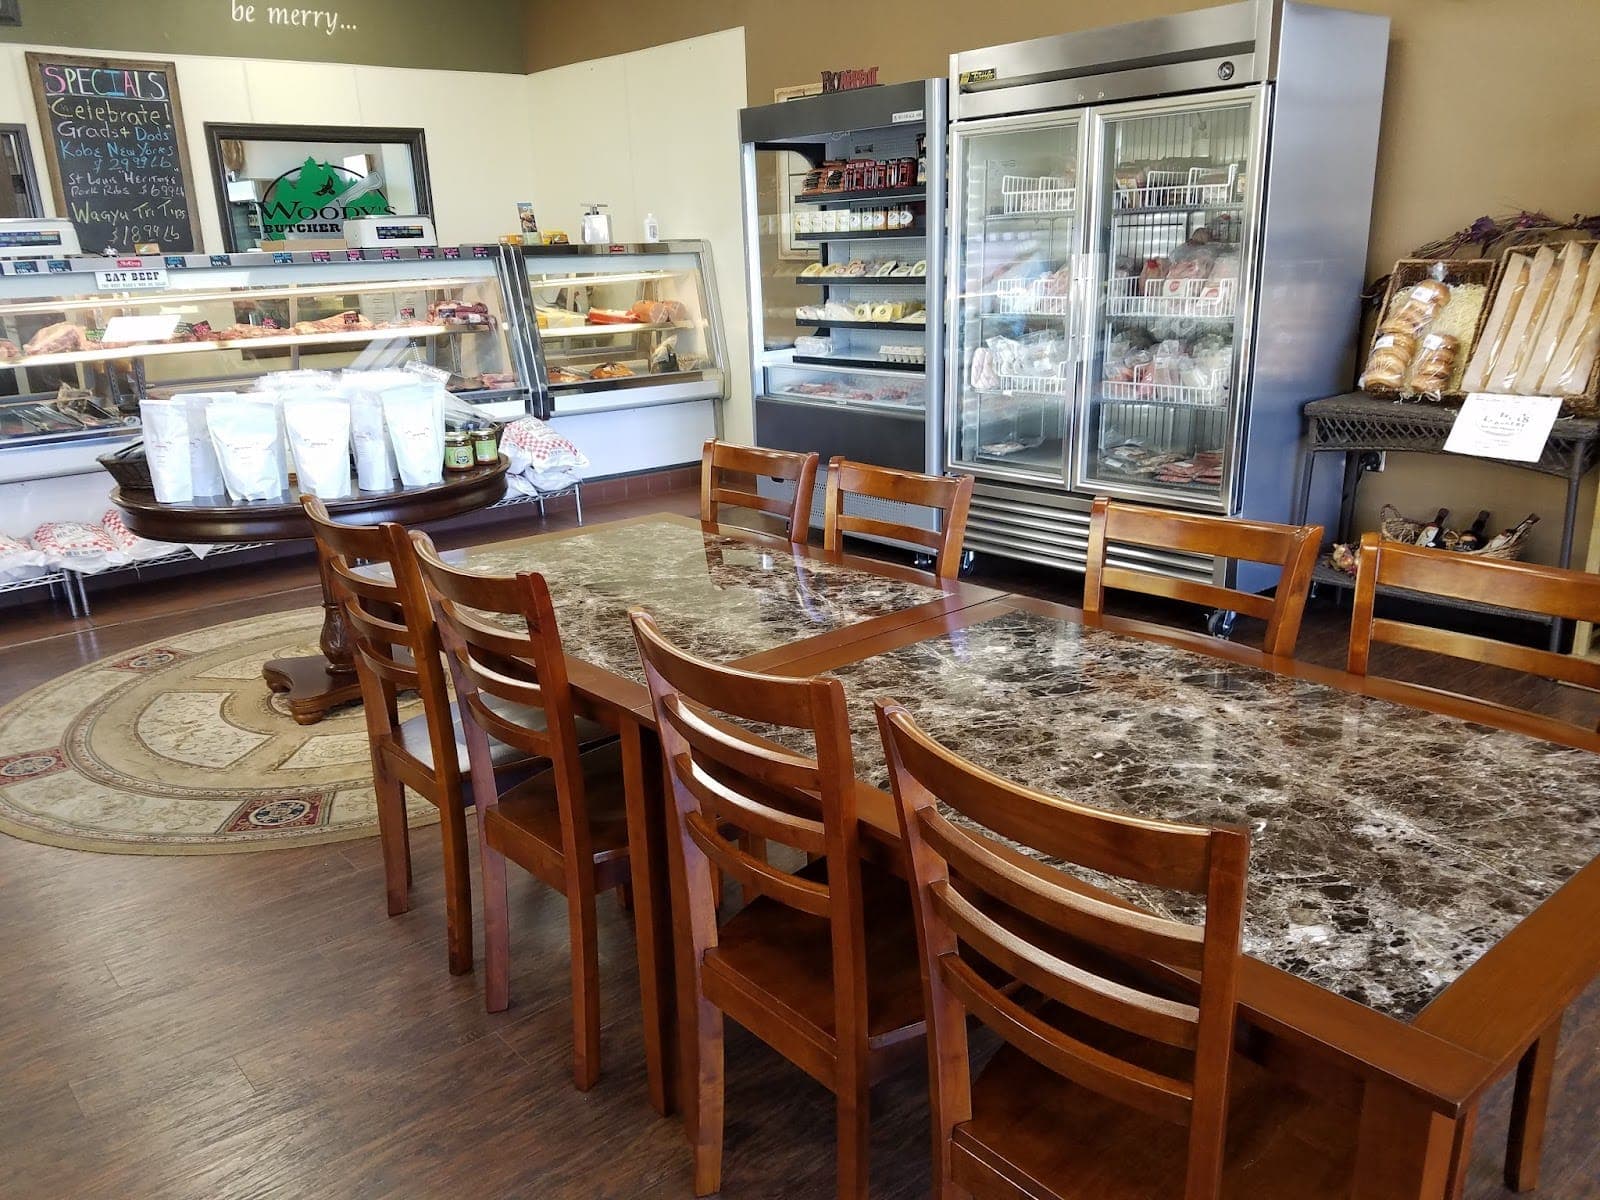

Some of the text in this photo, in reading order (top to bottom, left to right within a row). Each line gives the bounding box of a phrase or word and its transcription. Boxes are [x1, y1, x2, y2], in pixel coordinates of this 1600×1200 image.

[231, 0, 357, 36] be merry...
[44, 66, 166, 100] SPECIALS
[50, 97, 172, 129] Celebrate!
[57, 120, 118, 139] Grads
[60, 140, 103, 160] Kobe
[106, 141, 135, 158] New
[263, 222, 342, 234] BUTCHER
[105, 271, 160, 283] EAT BEEF
